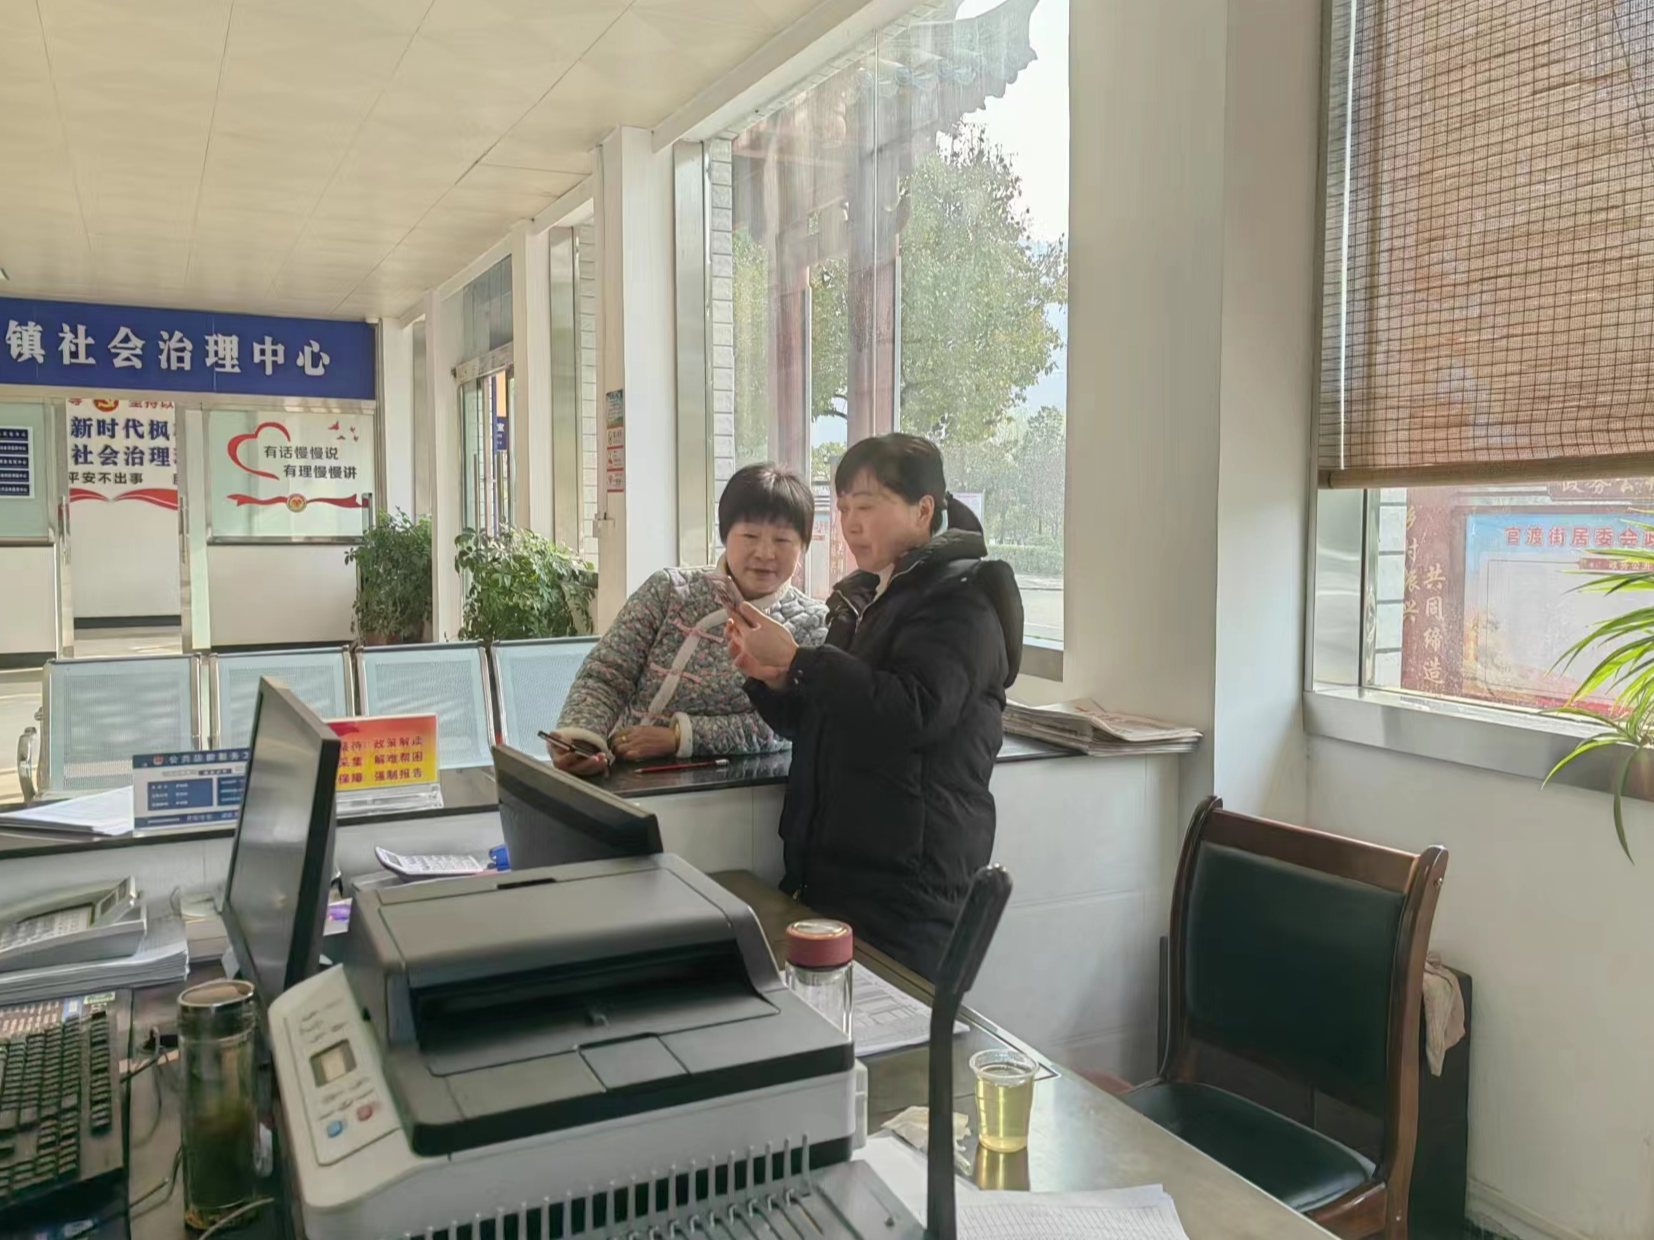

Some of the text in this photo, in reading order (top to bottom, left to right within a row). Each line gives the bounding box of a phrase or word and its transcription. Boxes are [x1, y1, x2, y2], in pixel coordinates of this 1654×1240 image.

[5, 319, 331, 377] 镇社会治理中心
[71, 416, 176, 441] 新时代枫
[71, 444, 177, 467] 社会治理
[263, 445, 339, 460] 有话慢慢说
[68, 471, 144, 485] 平安不出事
[283, 464, 357, 480] 有理慢慢讲
[1422, 564, 1446, 685] 共同缔造
